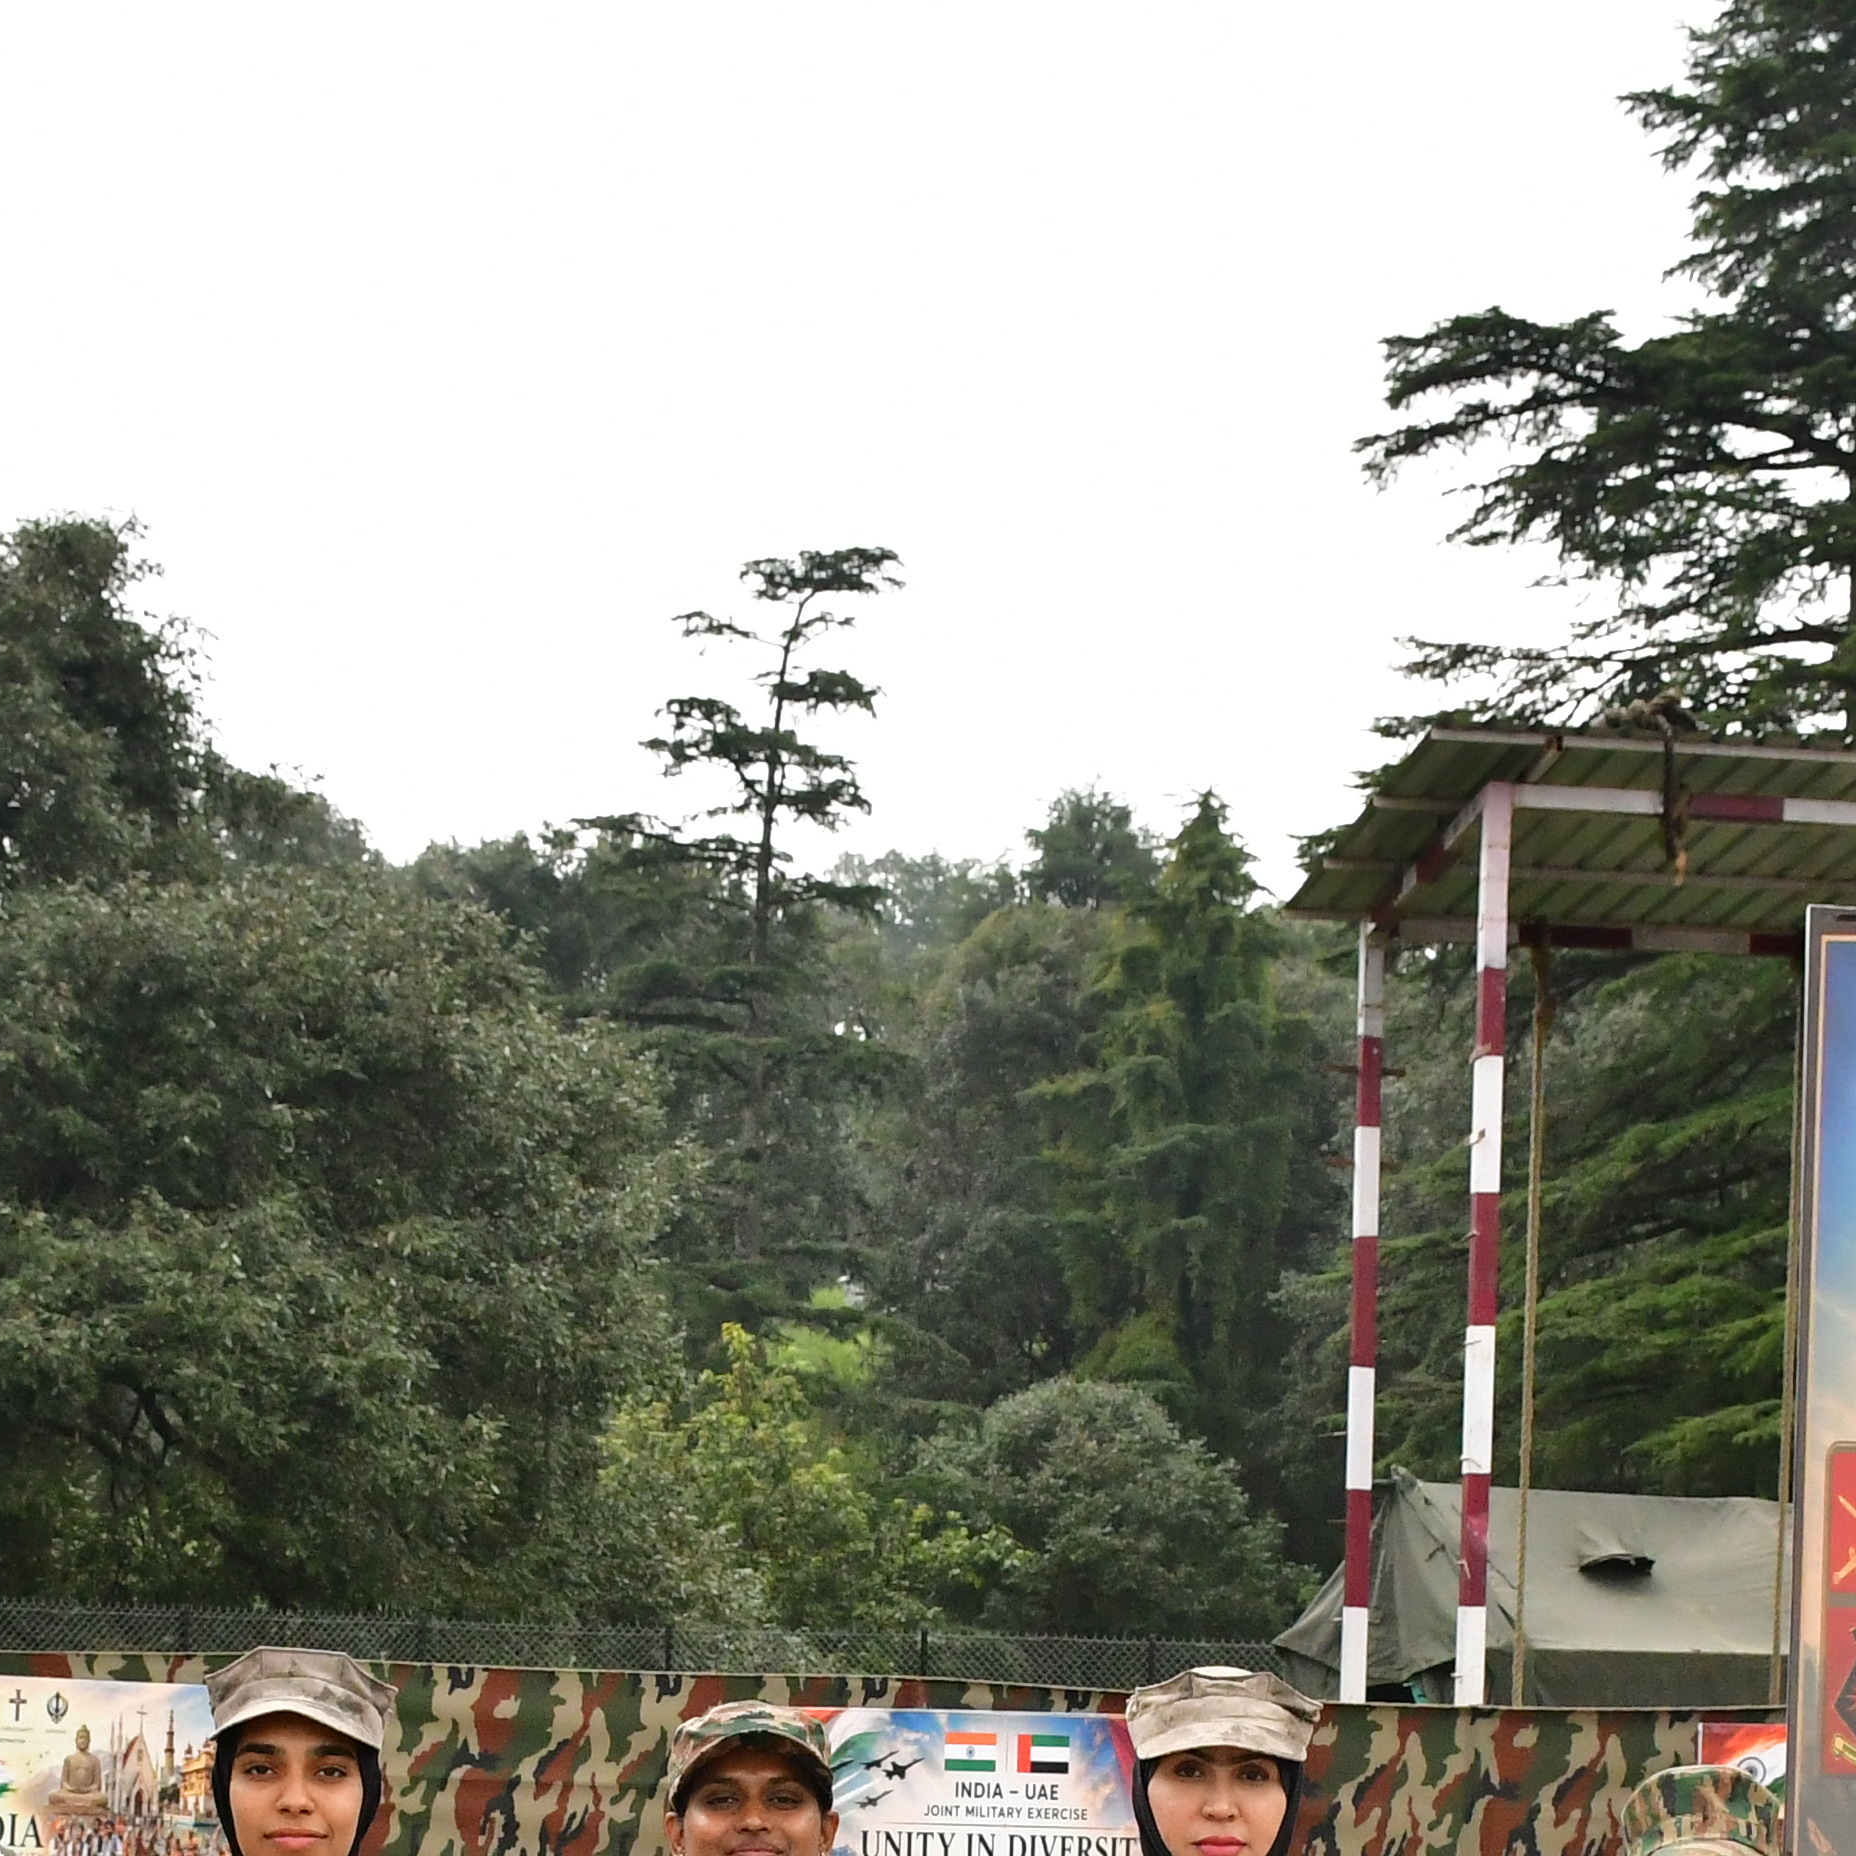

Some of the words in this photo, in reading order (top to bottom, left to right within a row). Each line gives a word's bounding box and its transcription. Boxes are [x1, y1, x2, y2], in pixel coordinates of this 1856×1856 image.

[954, 1781, 1004, 1800] INDIA
[1025, 1784, 1060, 1801] UAE
[924, 1804, 960, 1818] JOINT
[965, 1806, 1023, 1819] MILITARY
[1027, 1807, 1089, 1821] EXERCISE
